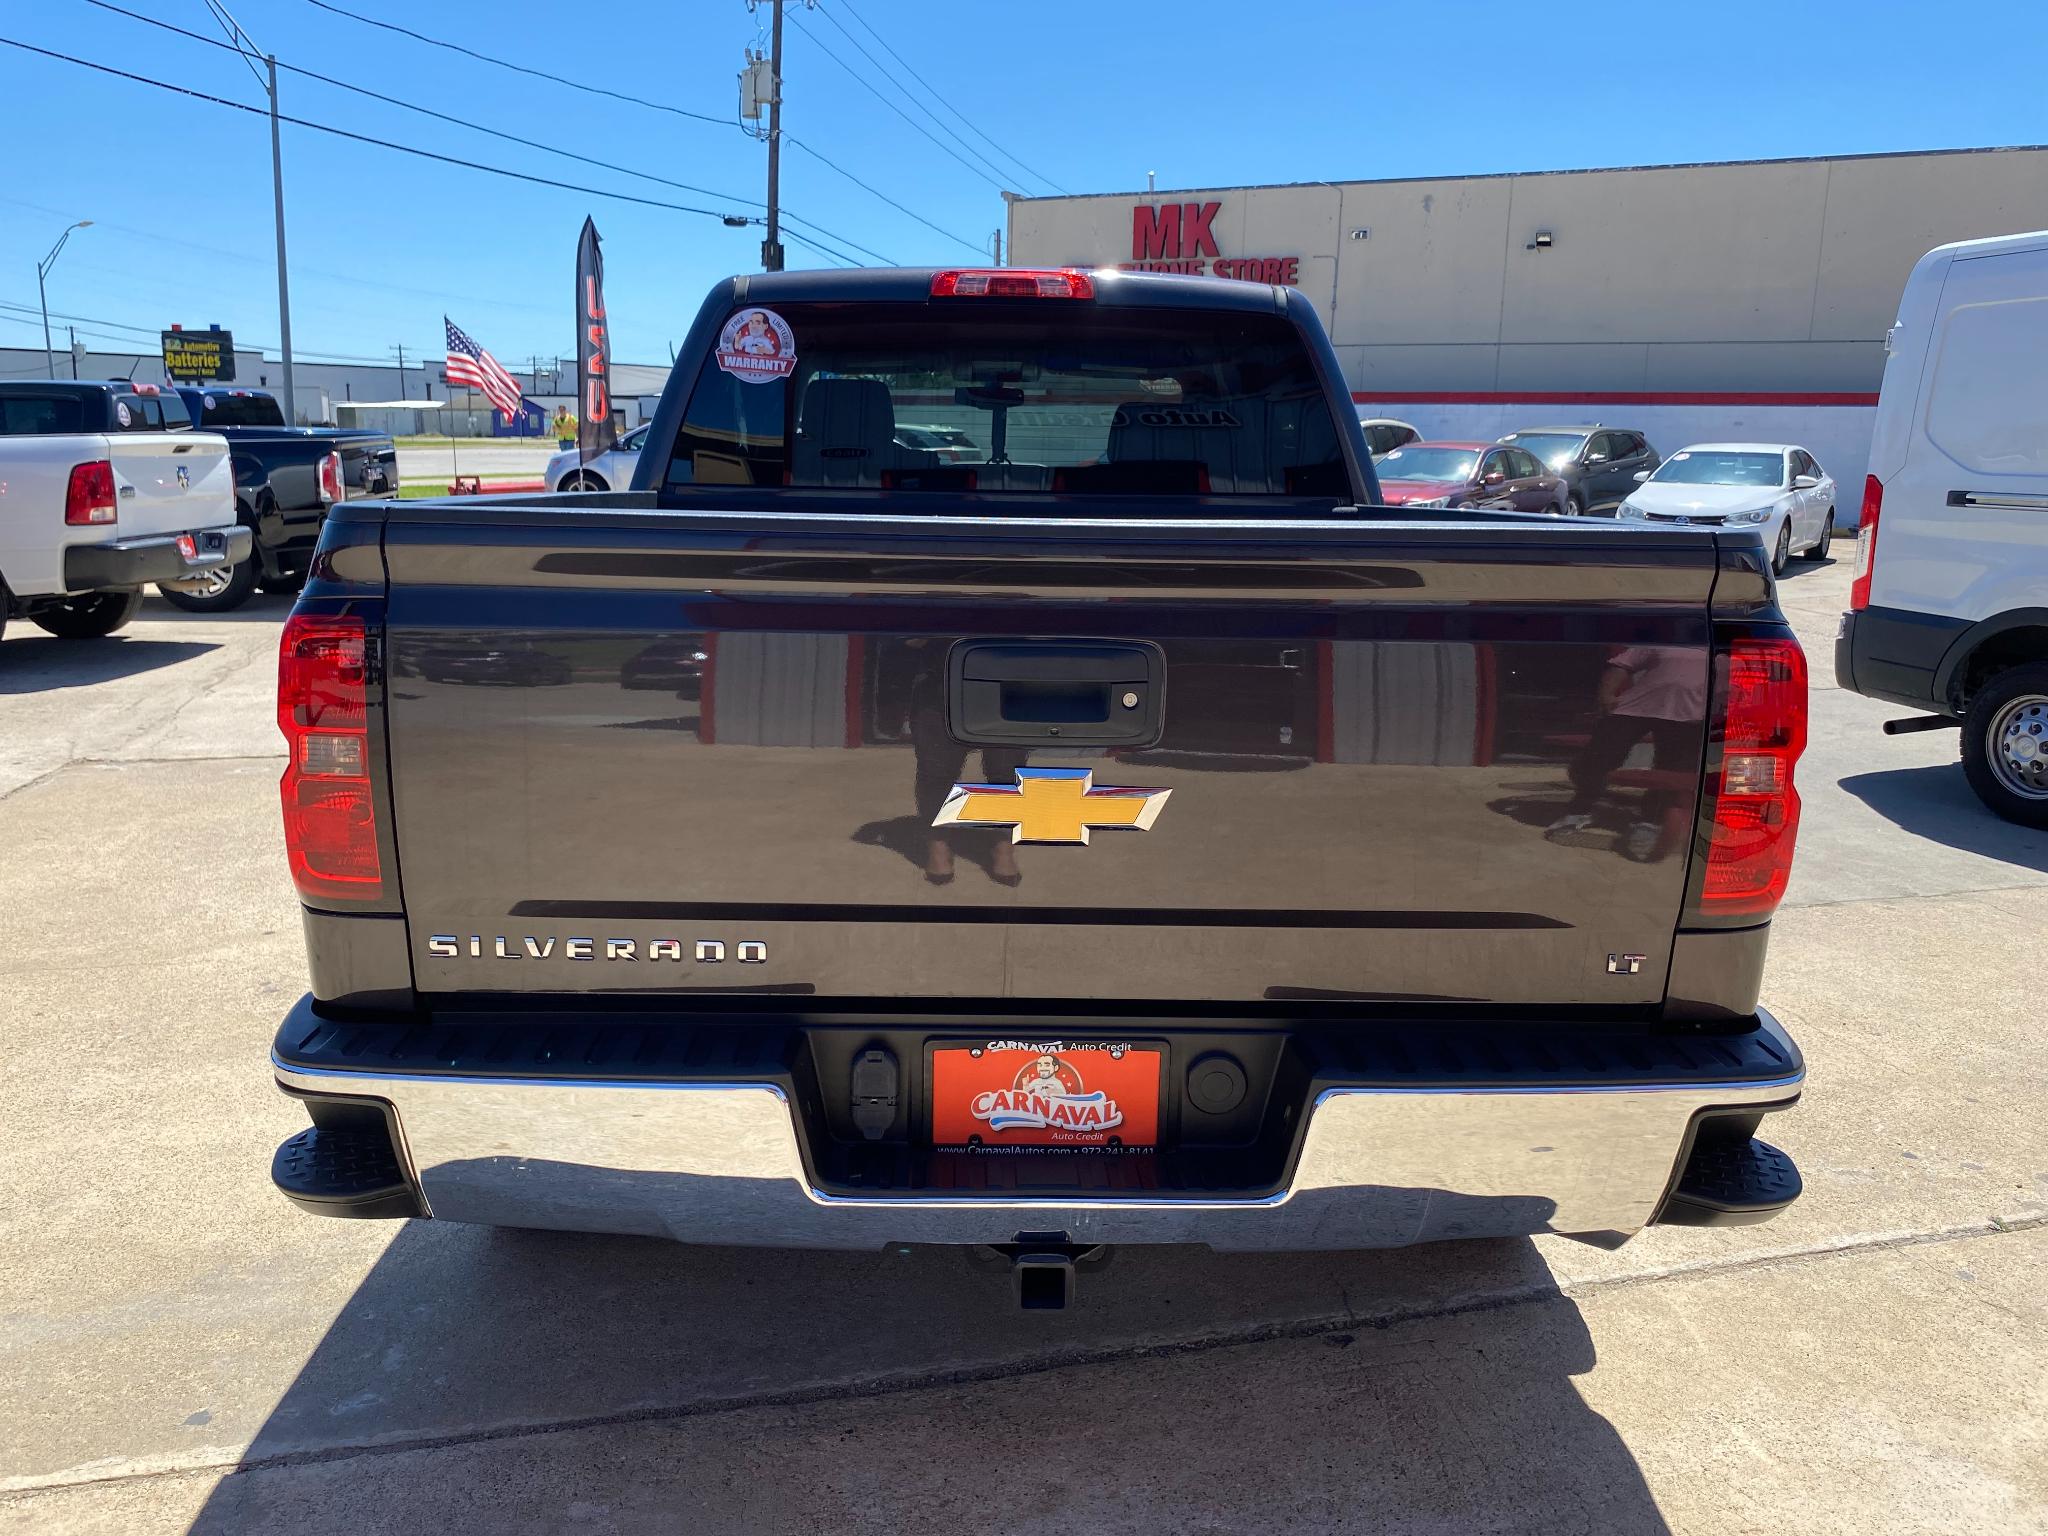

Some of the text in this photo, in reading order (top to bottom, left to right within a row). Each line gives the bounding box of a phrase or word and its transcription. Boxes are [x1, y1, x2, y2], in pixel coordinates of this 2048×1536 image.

[1132, 202, 1222, 260] MK
[1213, 257, 1298, 285] STORE
[730, 315, 746, 329] FREE
[166, 351, 221, 368] Batteries
[586, 275, 609, 424] GMC
[724, 355, 788, 372] WARRANTY
[428, 933, 768, 964] SILVERADO
[1606, 953, 1647, 975] LT
[986, 1040, 1132, 1054] CARNAVAL Auto Credit
[972, 1090, 1122, 1129] CARNAVAL
[1051, 1132, 1104, 1141] Auto Credit
